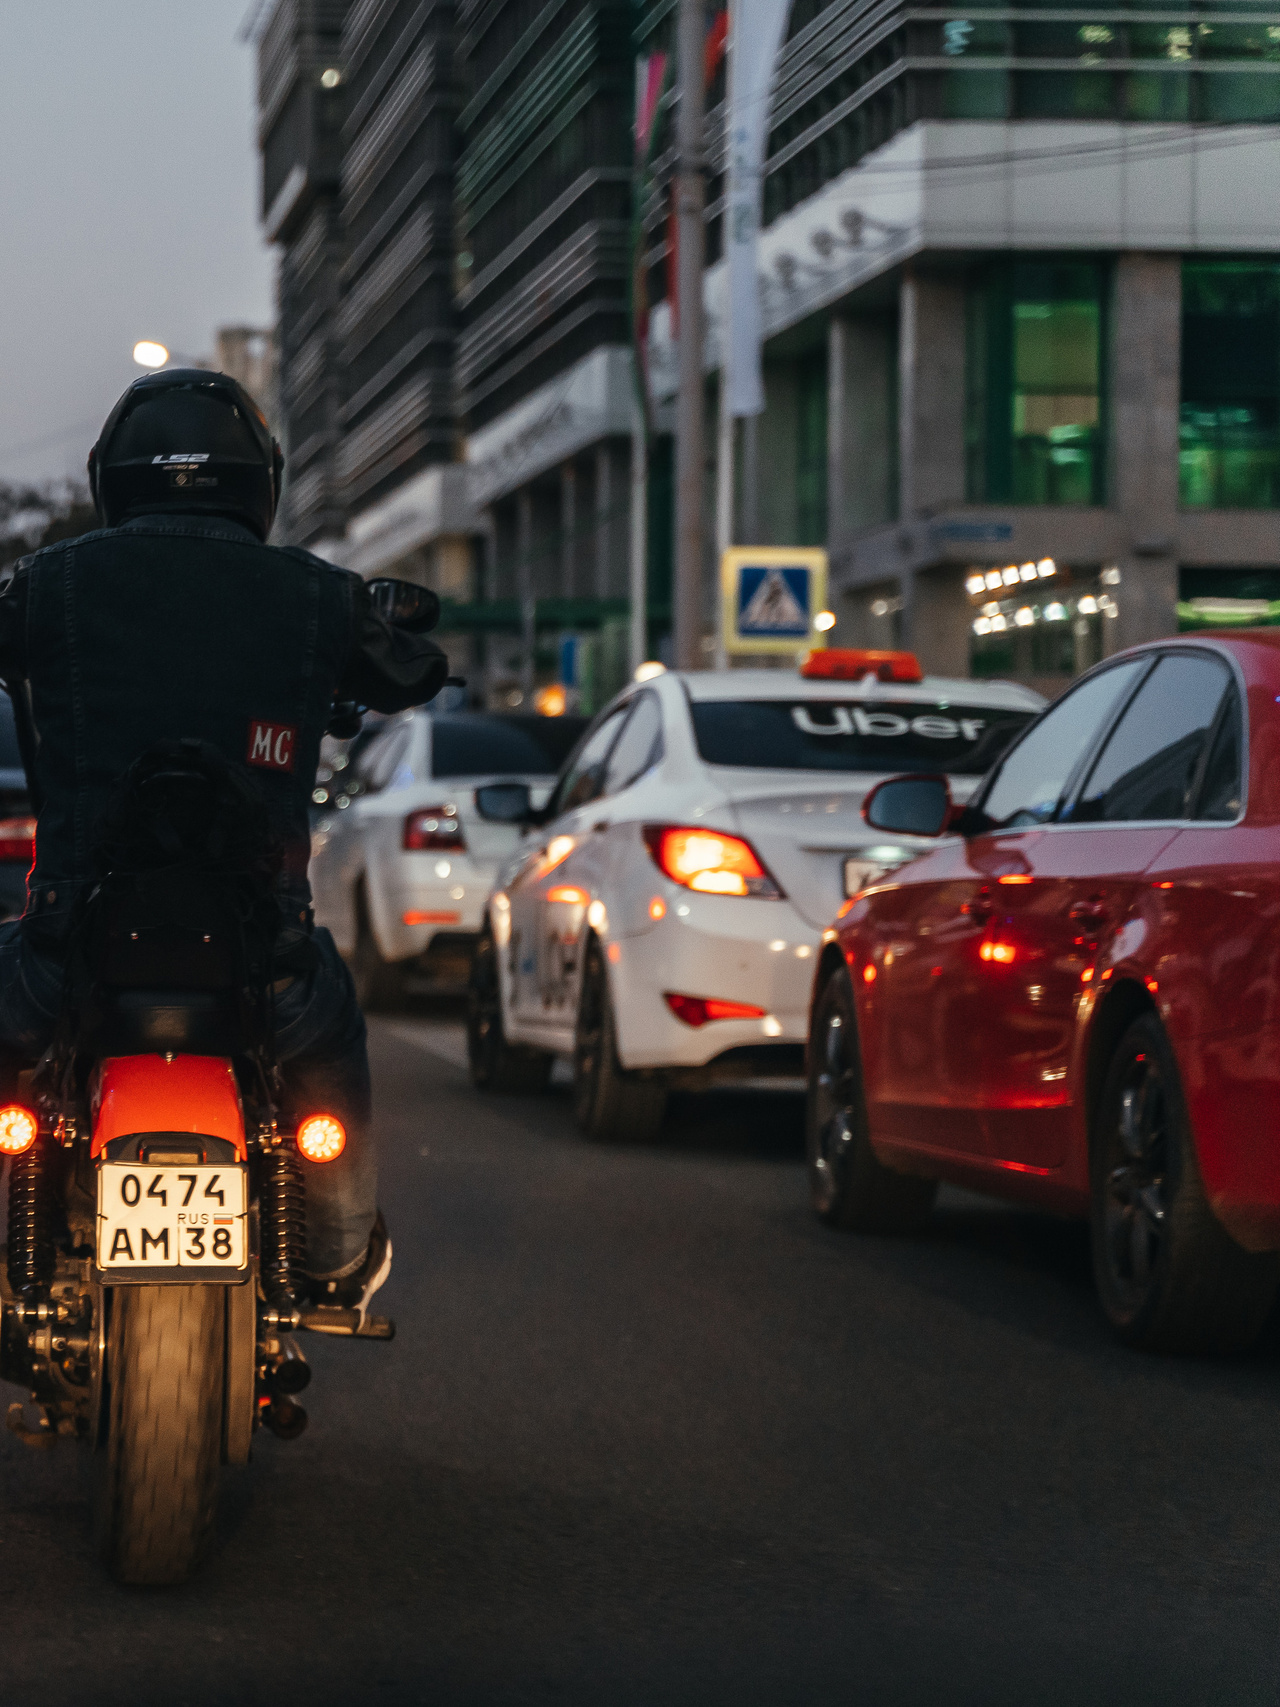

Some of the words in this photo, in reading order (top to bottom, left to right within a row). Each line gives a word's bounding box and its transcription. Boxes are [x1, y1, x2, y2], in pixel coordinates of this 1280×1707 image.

[151, 453, 210, 464] LS2
[251, 725, 291, 765] MC
[121, 1174, 225, 1207] 0474
[177, 1213, 210, 1225] RUS
[109, 1228, 169, 1261] AM
[185, 1227, 233, 1260] 38
